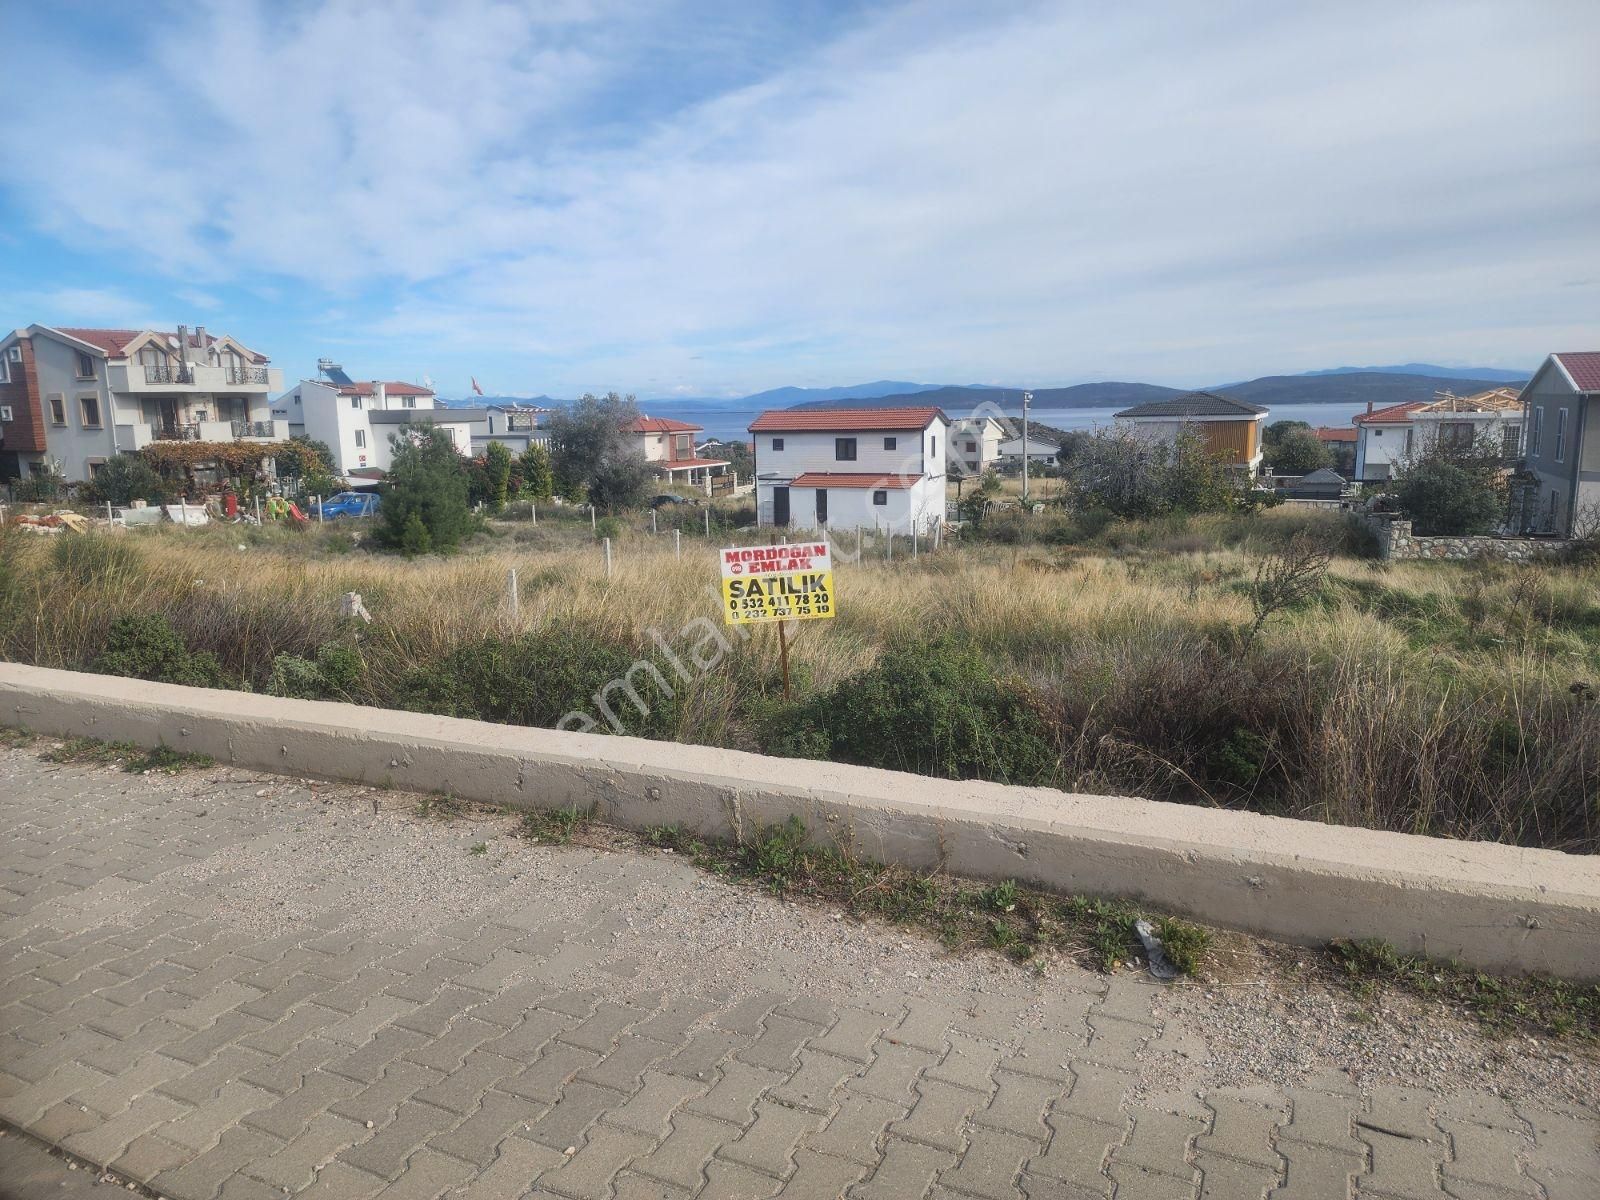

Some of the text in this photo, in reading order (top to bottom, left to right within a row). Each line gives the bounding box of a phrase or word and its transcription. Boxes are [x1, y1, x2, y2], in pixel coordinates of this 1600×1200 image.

[748, 559, 812, 573] EMLAK
[730, 574, 827, 599] SATILIK
[730, 593, 829, 610] 0 532 411 78 20
[744, 609, 767, 619] 232
[772, 607, 792, 617] 737
[797, 606, 811, 615] 75
[815, 605, 829, 614] 19
